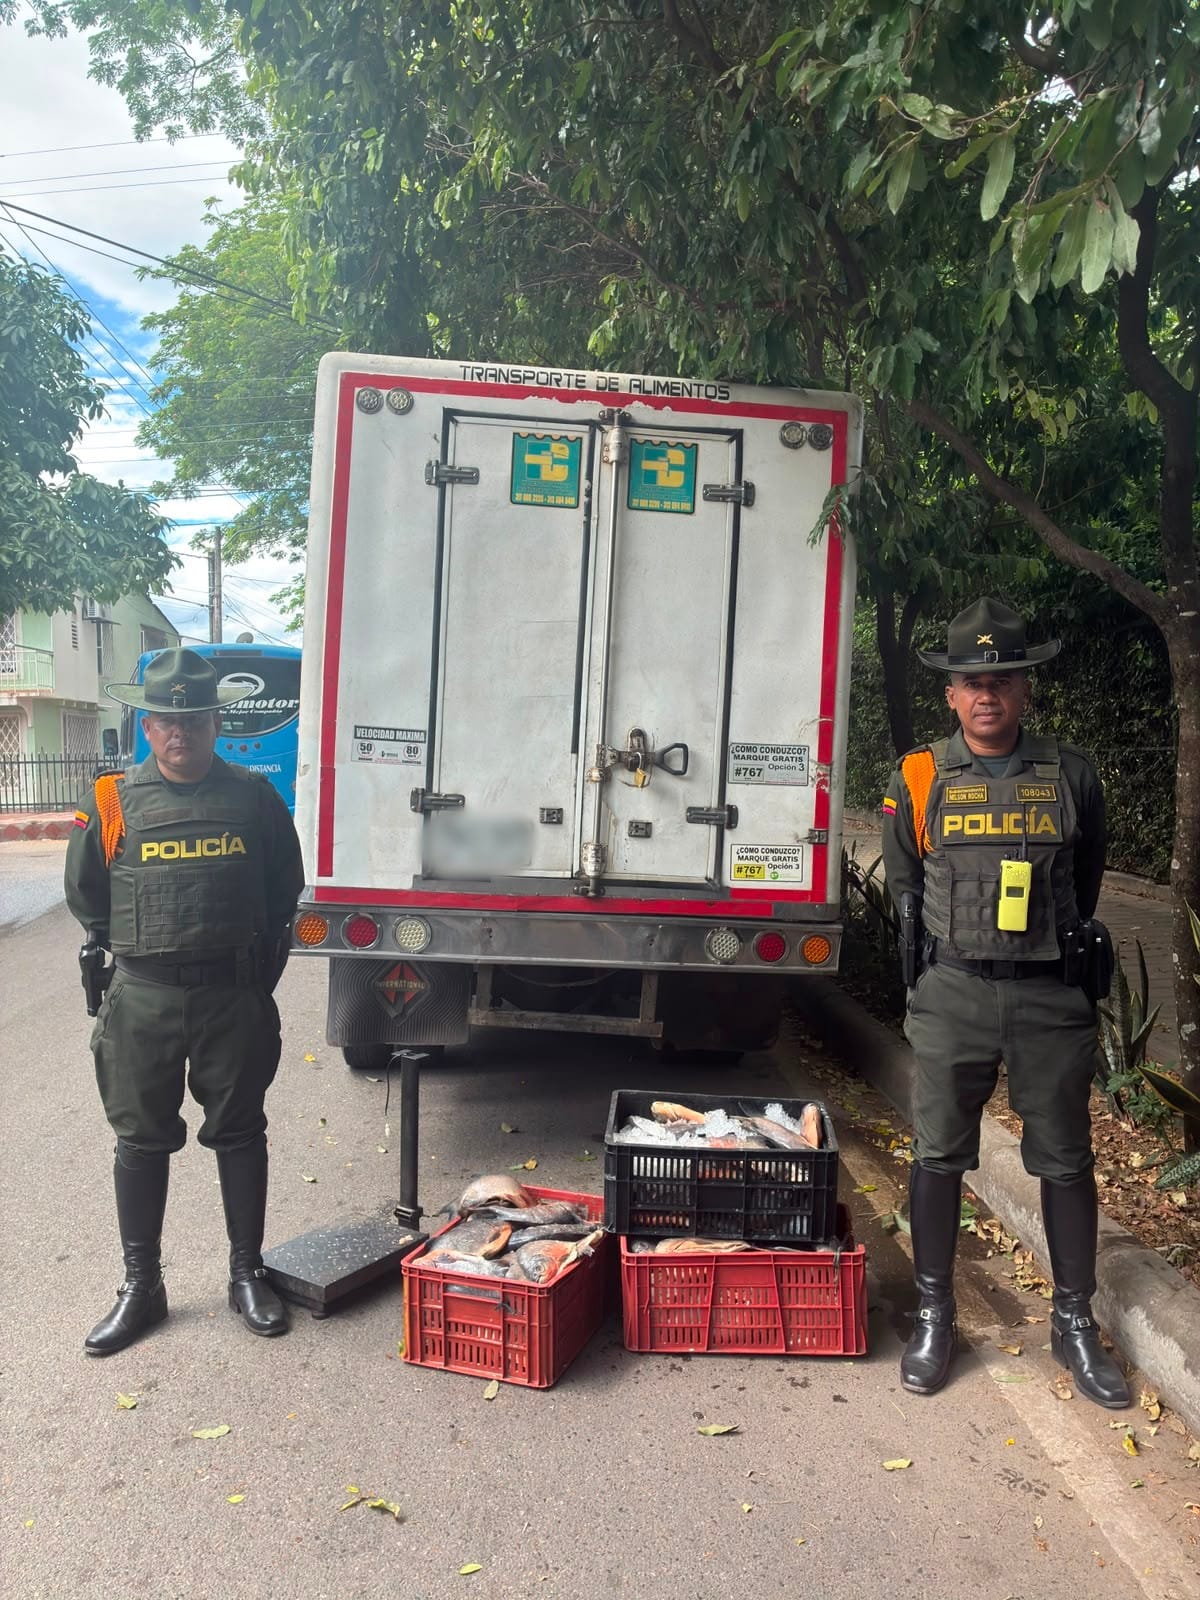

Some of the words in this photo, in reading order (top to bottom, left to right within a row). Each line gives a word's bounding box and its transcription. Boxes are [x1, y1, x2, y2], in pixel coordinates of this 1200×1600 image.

[459, 365, 586, 389] TRANSPORTE
[596, 376, 619, 392] DE
[629, 378, 730, 401] ALIMENTOS
[356, 727, 395, 739] VELOCIDAD
[360, 742, 372, 752] 50
[406, 745, 419, 755] 80
[759, 746, 807, 755] CONDUZCO?
[733, 754, 770, 762] MARQUE
[772, 755, 803, 763] GRATIS
[249, 764, 282, 774] DISTANCIA
[734, 766, 763, 777] #767
[768, 763, 797, 771] Opción
[798, 763, 805, 772] 3
[1021, 788, 1051, 797] 108043
[943, 805, 1057, 837] POLICÍA
[141, 831, 246, 862] POLICÍA
[760, 847, 800, 855] CONDUZCO?
[737, 855, 770, 863] MARQUE
[772, 855, 799, 863] GRATIS
[736, 865, 762, 875] #767
[767, 863, 793, 871] Opción
